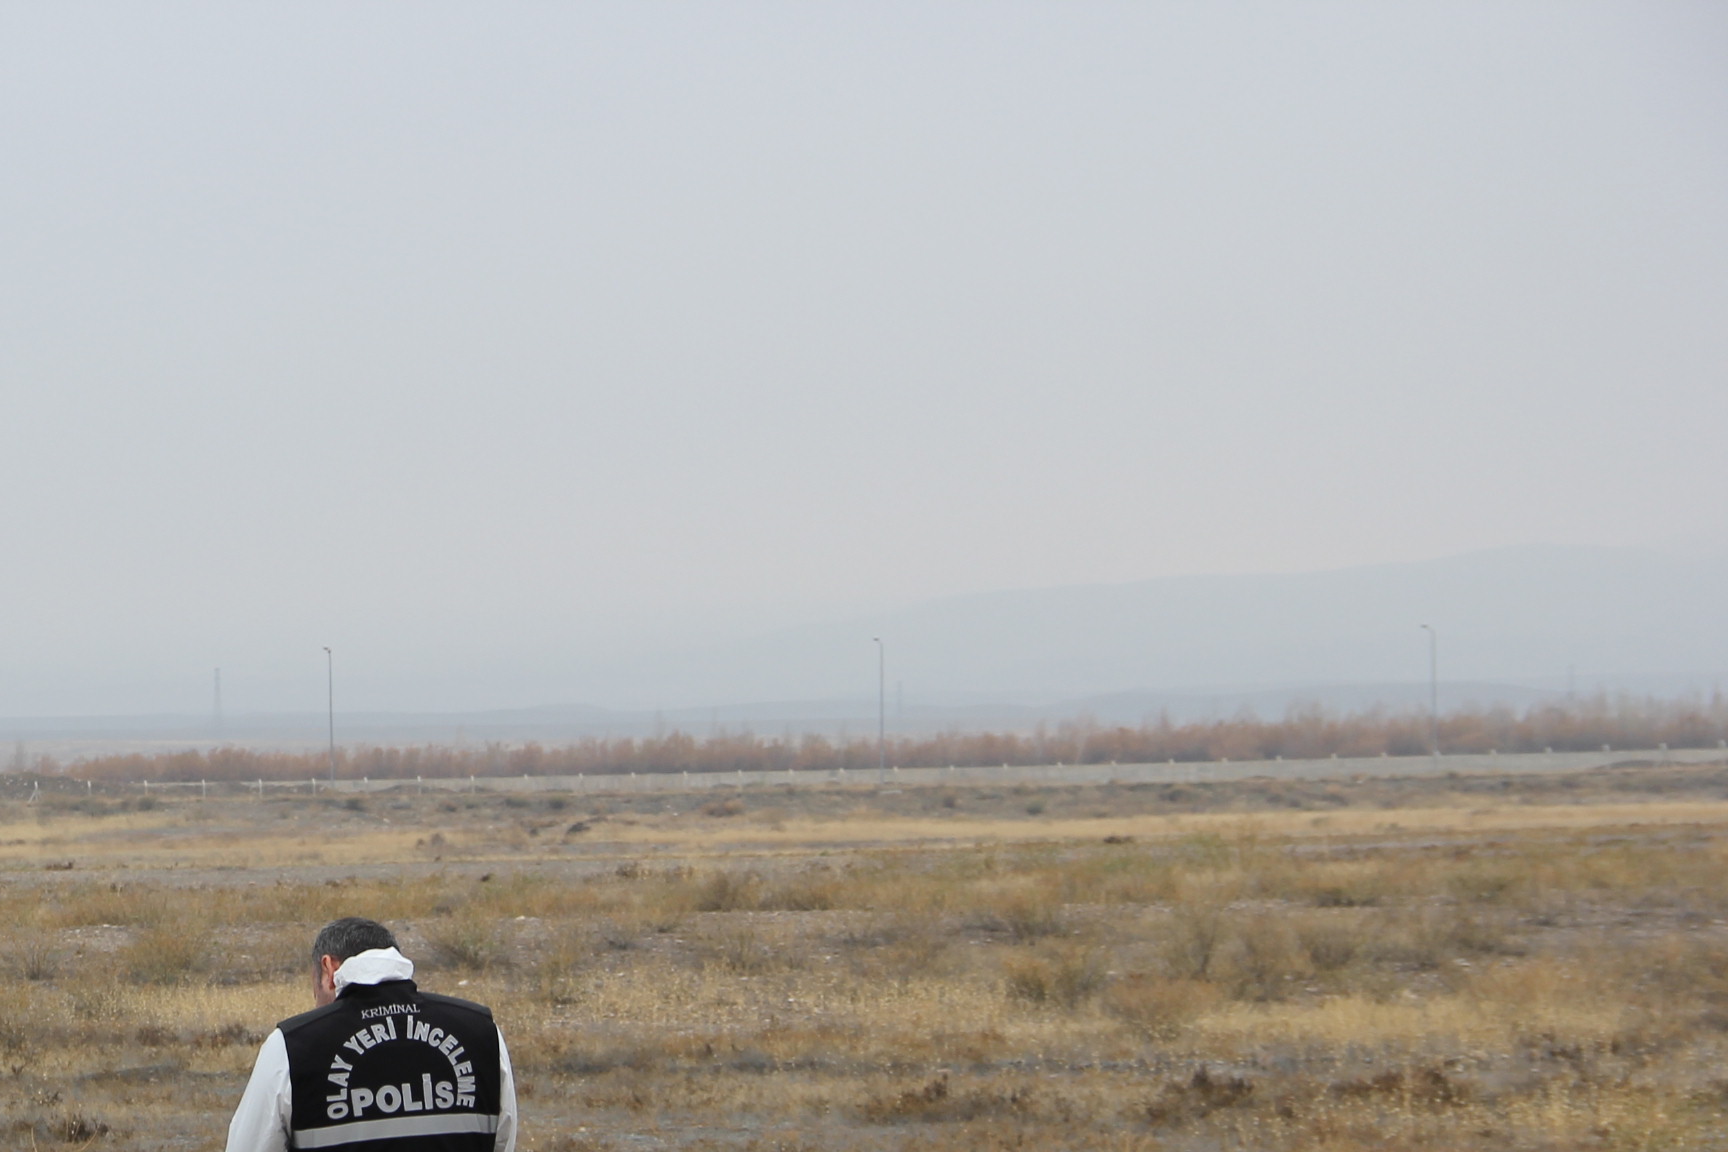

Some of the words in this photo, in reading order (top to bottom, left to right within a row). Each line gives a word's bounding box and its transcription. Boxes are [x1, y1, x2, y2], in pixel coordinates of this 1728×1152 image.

[361, 1003, 421, 1019] KRİMİNAL
[326, 1054, 353, 1120] OLAY
[343, 1016, 397, 1055] YERİ
[406, 1015, 476, 1108] İNCELEME
[350, 1073, 454, 1117] POLİS
